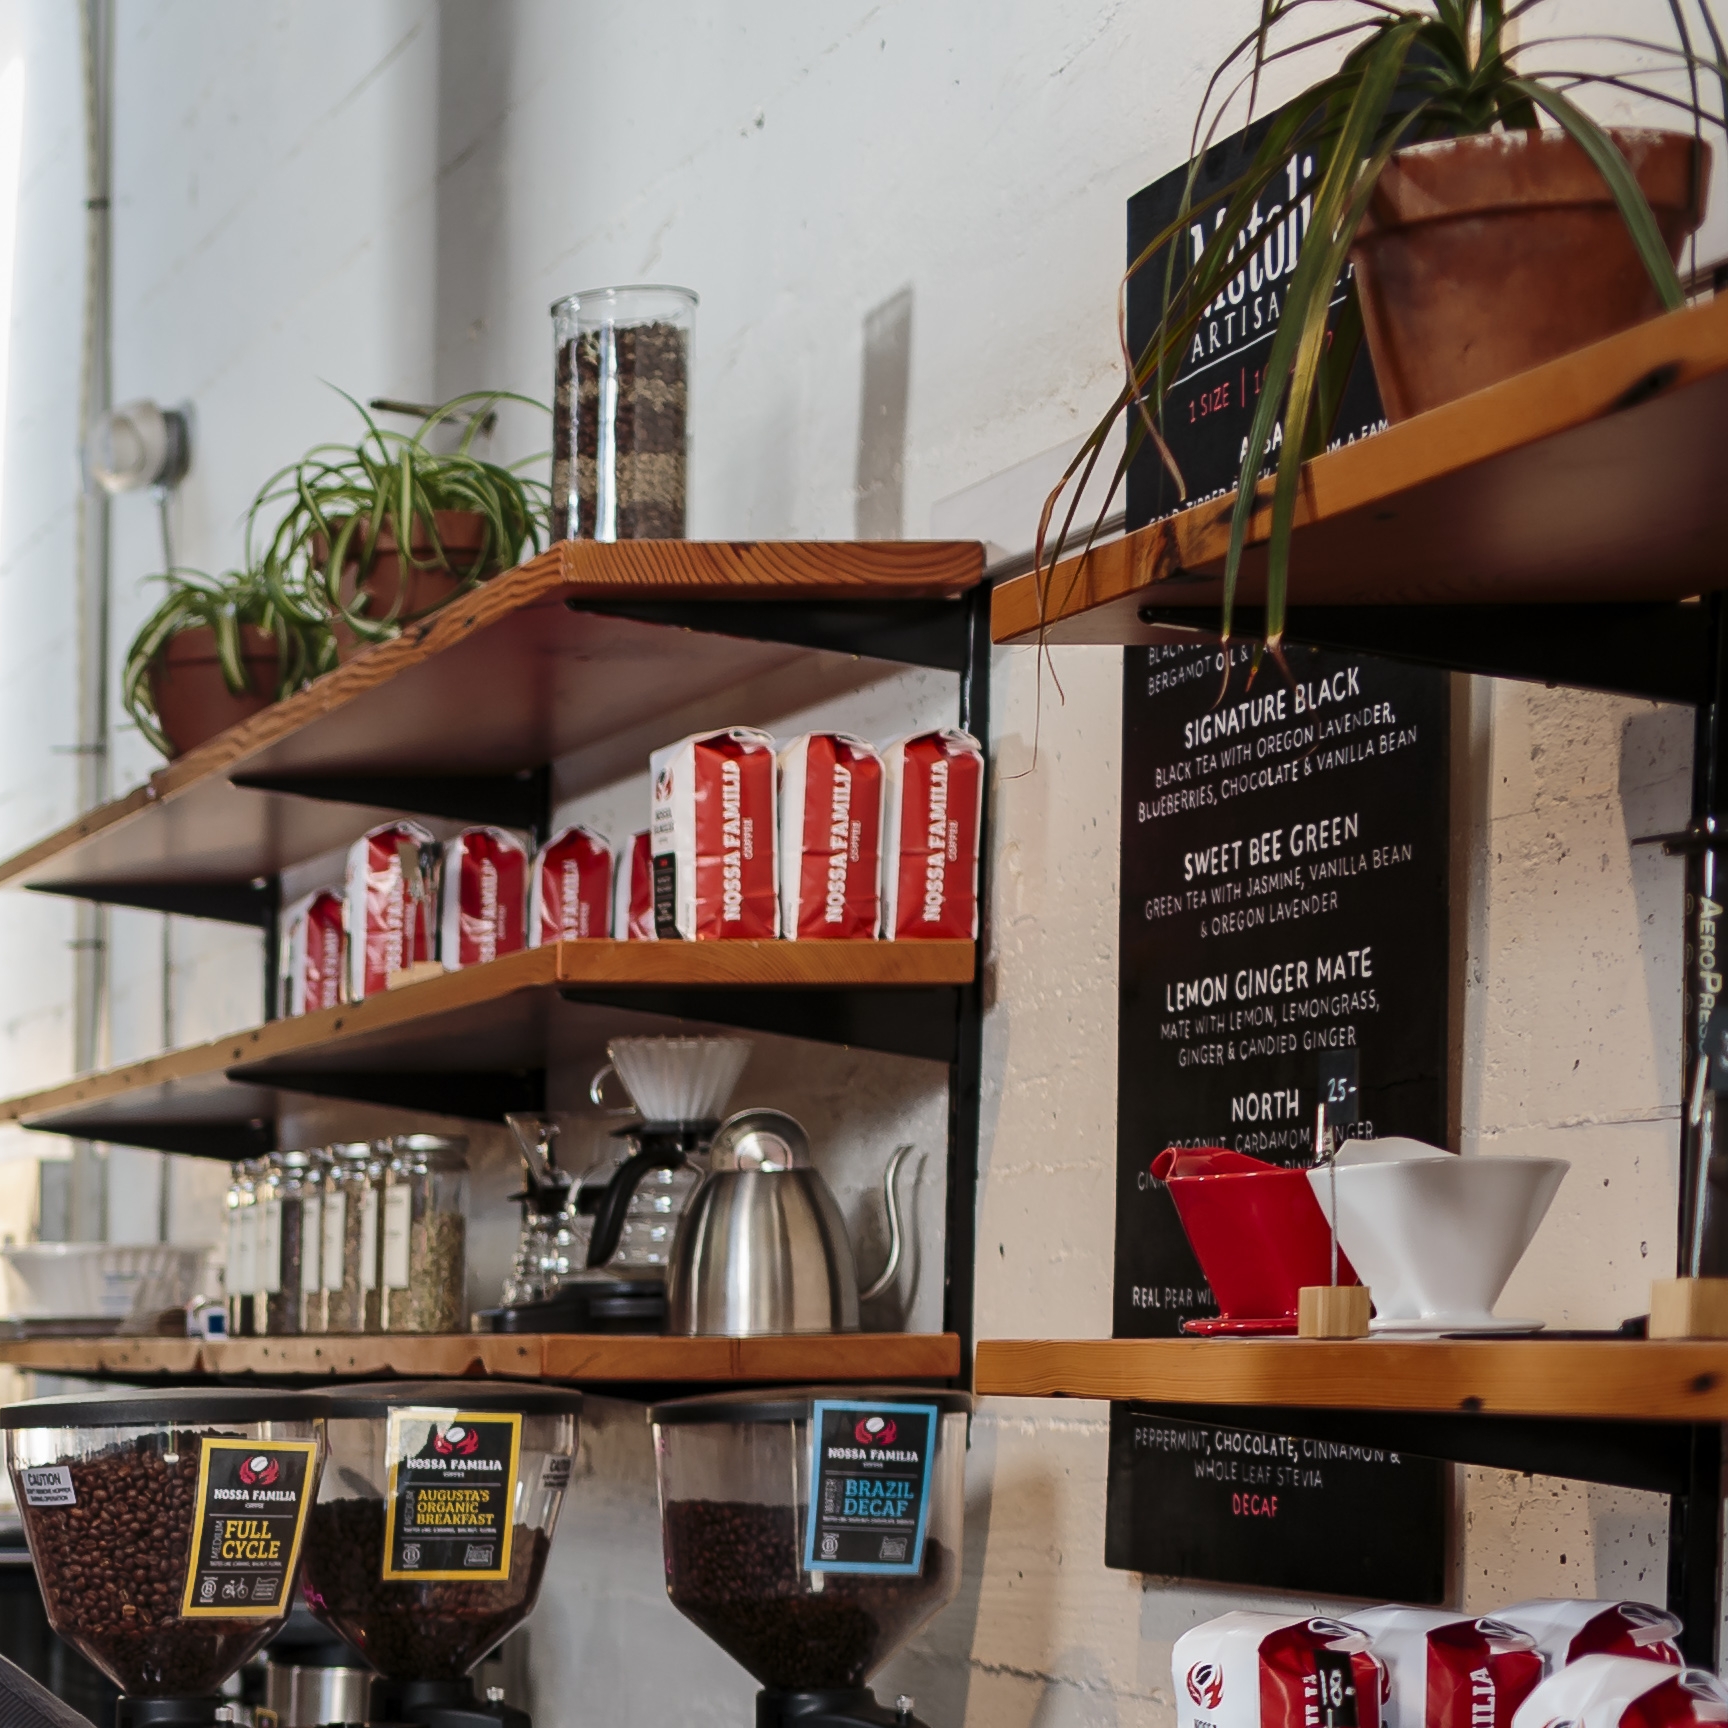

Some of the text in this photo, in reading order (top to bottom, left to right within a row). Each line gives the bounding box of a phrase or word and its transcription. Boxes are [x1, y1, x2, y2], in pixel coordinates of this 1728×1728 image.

[1200, 382, 1231, 418] SIZE
[1148, 655, 1212, 697] BERGAMOT
[1184, 666, 1361, 750] SIGNATURE BLACK
[1155, 701, 1397, 789] BLACK TEA WITH OREGON LAVENDER,
[1137, 725, 1418, 823] BLUEBERRIES, CHOCOLATE & VANILLA BEAN
[922, 760, 949, 923] NOSSA FAMILIA
[1184, 813, 1360, 881] SWEET BEE GREEN
[722, 850, 741, 922] NOSSA
[825, 851, 848, 923] NOSSA
[1145, 844, 1413, 921] GREEN TEA WITH JASMINE, VANILLA BEAN
[1200, 891, 1339, 939] & OREGON LAVENDER
[1166, 947, 1373, 1013] LEMON GINGER MATE
[1160, 989, 1381, 1041] MATE WITH LEMON, LEMONGRASS,
[1178, 1026, 1357, 1067] GINGER & CANDIED GINGER
[1232, 1088, 1299, 1123] NORTH
[1235, 1126, 1314, 1154] CARDAMOM,
[828, 1447, 919, 1462] NOSSA FAMILIA
[1134, 1426, 1300, 1463] PEPPERMINT, CHOCOLATE,
[28, 1472, 62, 1487] CAUTION
[407, 1456, 502, 1471] NOSSA FAMILIA
[1194, 1459, 1324, 1489] WHOLE STEVIA
[214, 1489, 296, 1502] NOSSA FAMILIA
[417, 1489, 490, 1501] AUGUSTA'S
[845, 1478, 915, 1499] BRAZIL
[1232, 1492, 1279, 1518] DECAF
[416, 1513, 495, 1526] BREAKFAST
[417, 1501, 479, 1514] ORGANIC
[843, 1499, 909, 1517] DECAF
[210, 1520, 225, 1560] MEDIUM
[225, 1520, 272, 1539] FULL
[222, 1541, 281, 1560] CYCLE
